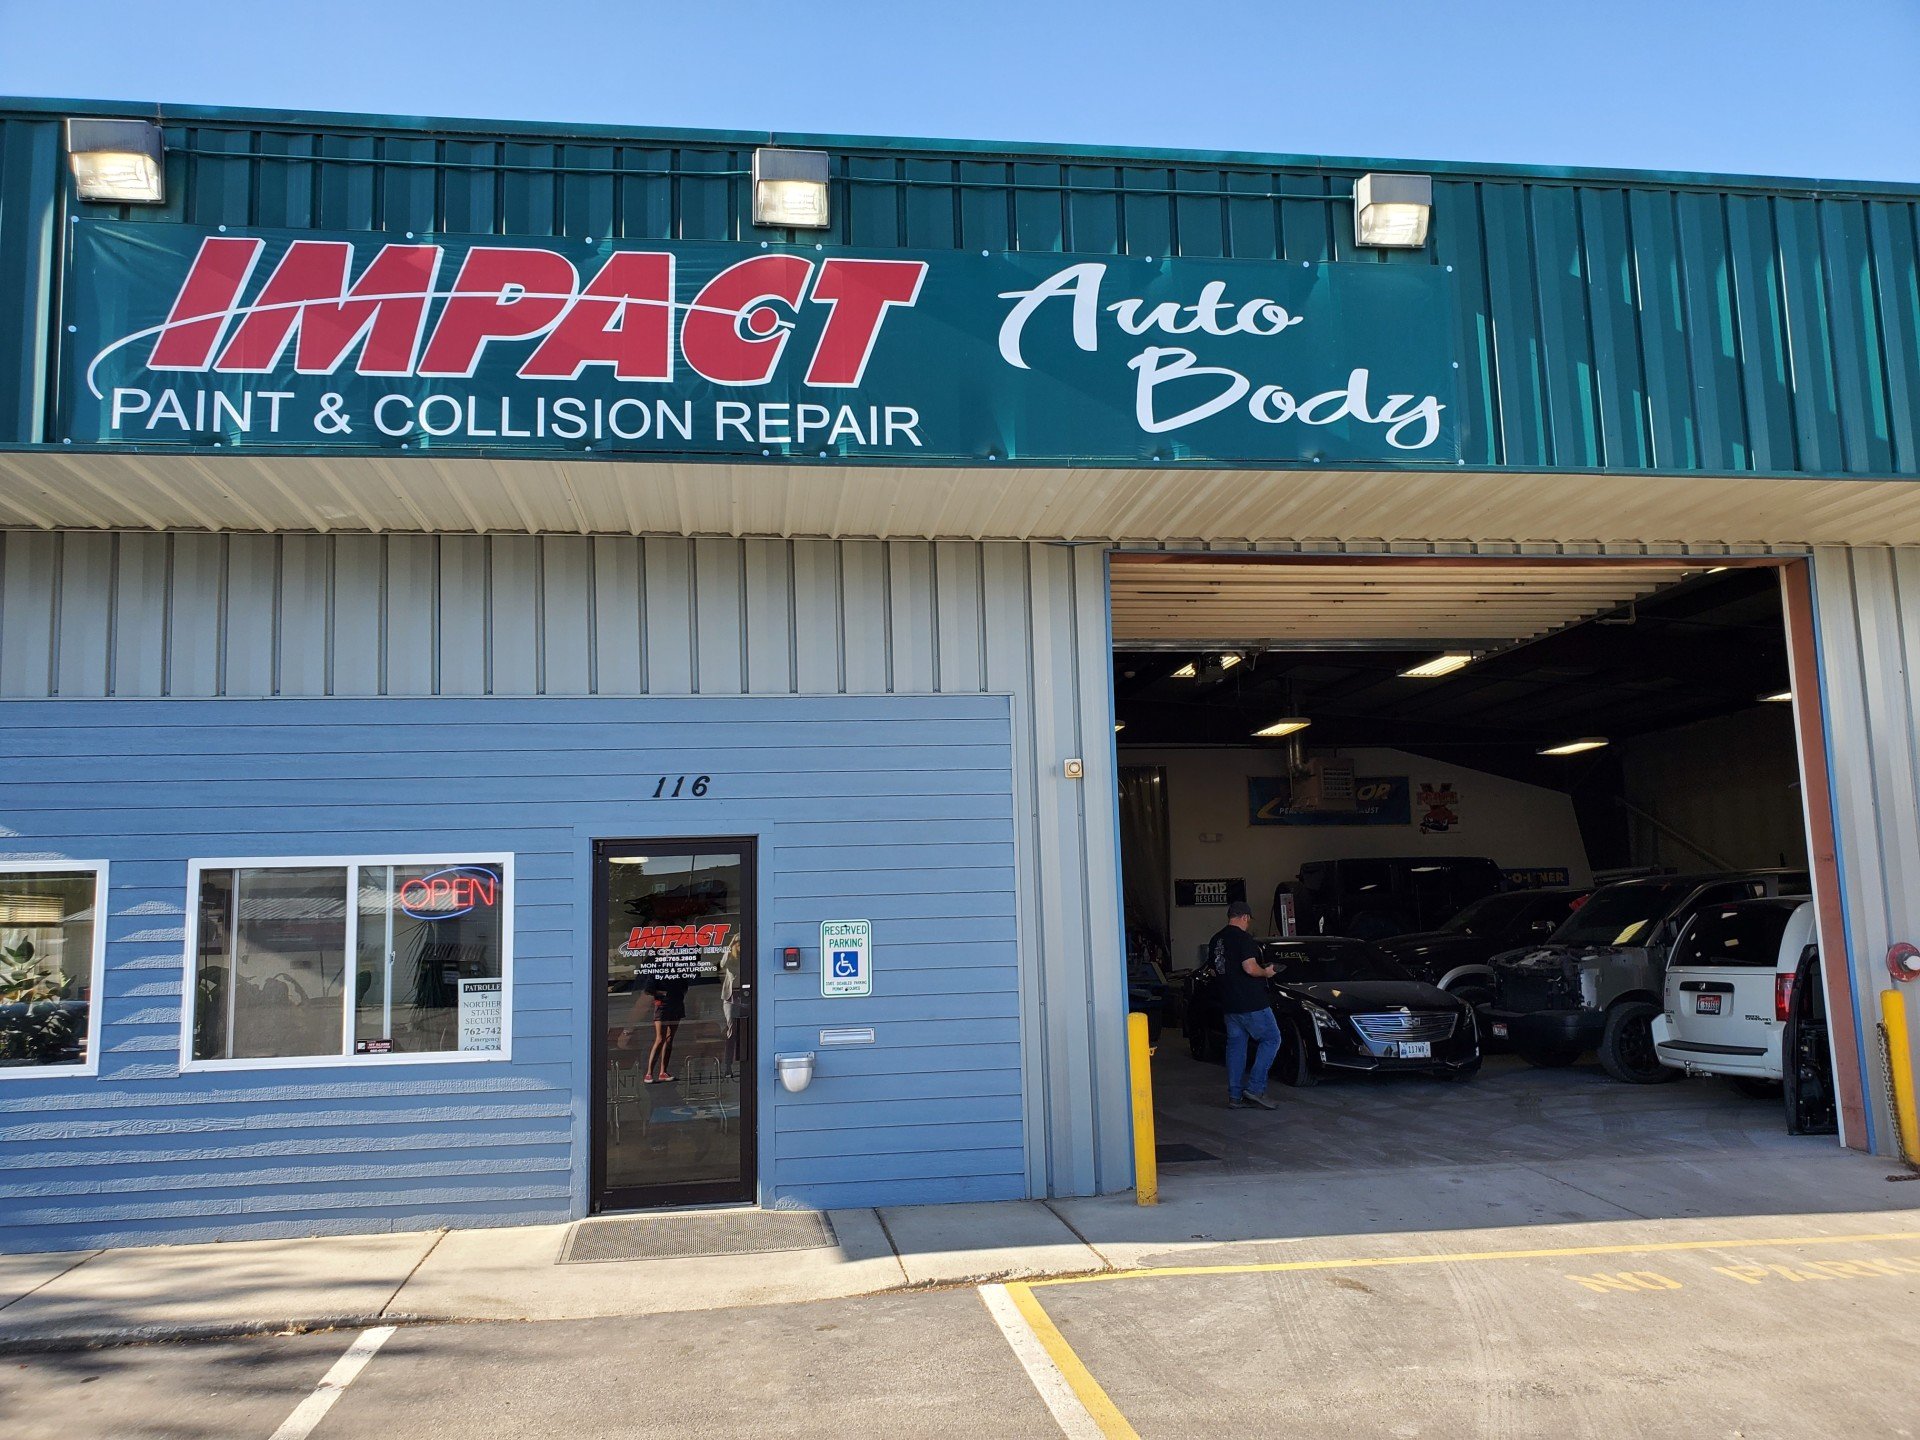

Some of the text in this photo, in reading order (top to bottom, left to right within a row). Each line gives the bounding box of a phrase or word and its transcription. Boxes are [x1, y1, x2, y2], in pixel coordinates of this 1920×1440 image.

[146, 235, 929, 390] IMPACT
[997, 262, 1304, 370] Auto
[1126, 345, 1448, 450] Body
[111, 387, 923, 447] PAINT & COLLISION REPAIR
[652, 775, 711, 798] 116
[400, 877, 495, 910] OPEN
[627, 924, 731, 949] IMPACT
[825, 925, 867, 935] RESERVED
[622, 949, 646, 957] PAINT
[658, 948, 702, 956] COLLISION
[829, 938, 863, 948] PARKING
[464, 983, 502, 992] PATROLLE
[463, 1000, 502, 1008] NORTHER
[471, 1008, 500, 1016] STATES
[464, 1027, 502, 1036] 762-742
[1563, 1271, 1684, 1294] NO
